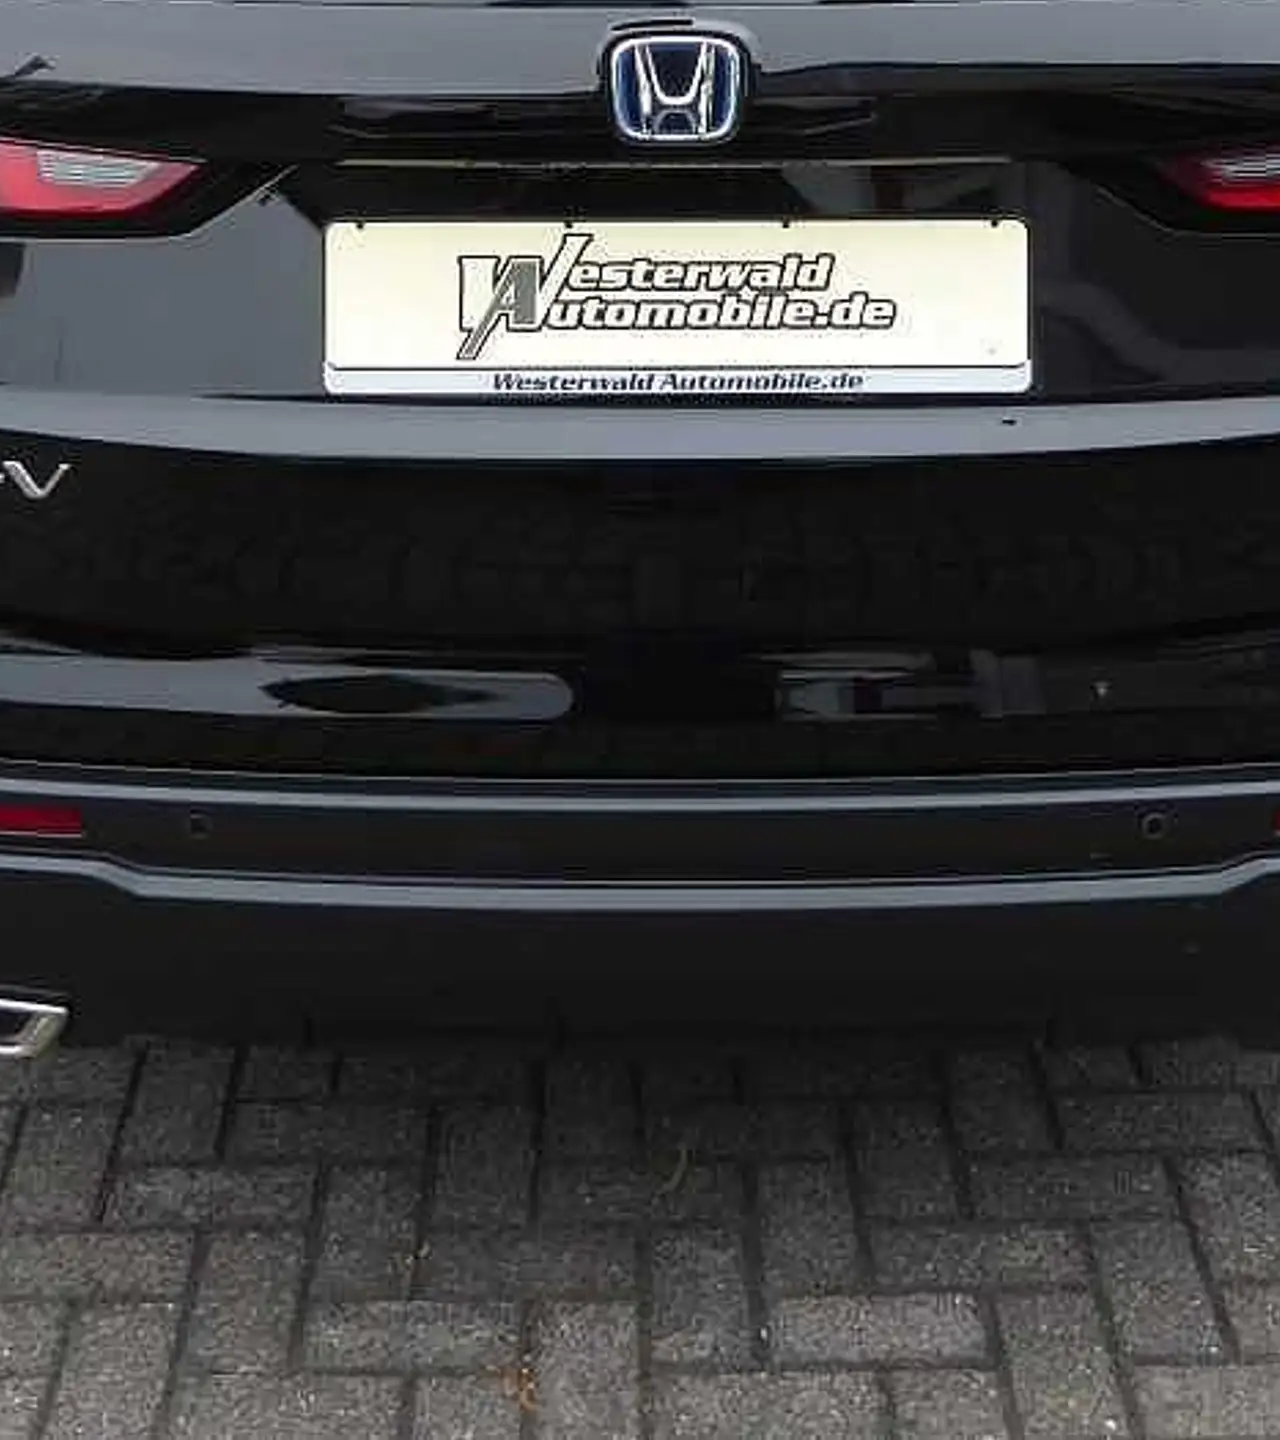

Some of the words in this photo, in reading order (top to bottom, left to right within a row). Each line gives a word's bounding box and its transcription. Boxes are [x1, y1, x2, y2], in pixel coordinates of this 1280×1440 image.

[457, 233, 835, 332] Westerwald
[493, 372, 655, 392] Westerwald
[659, 372, 865, 392] Automobile.de
